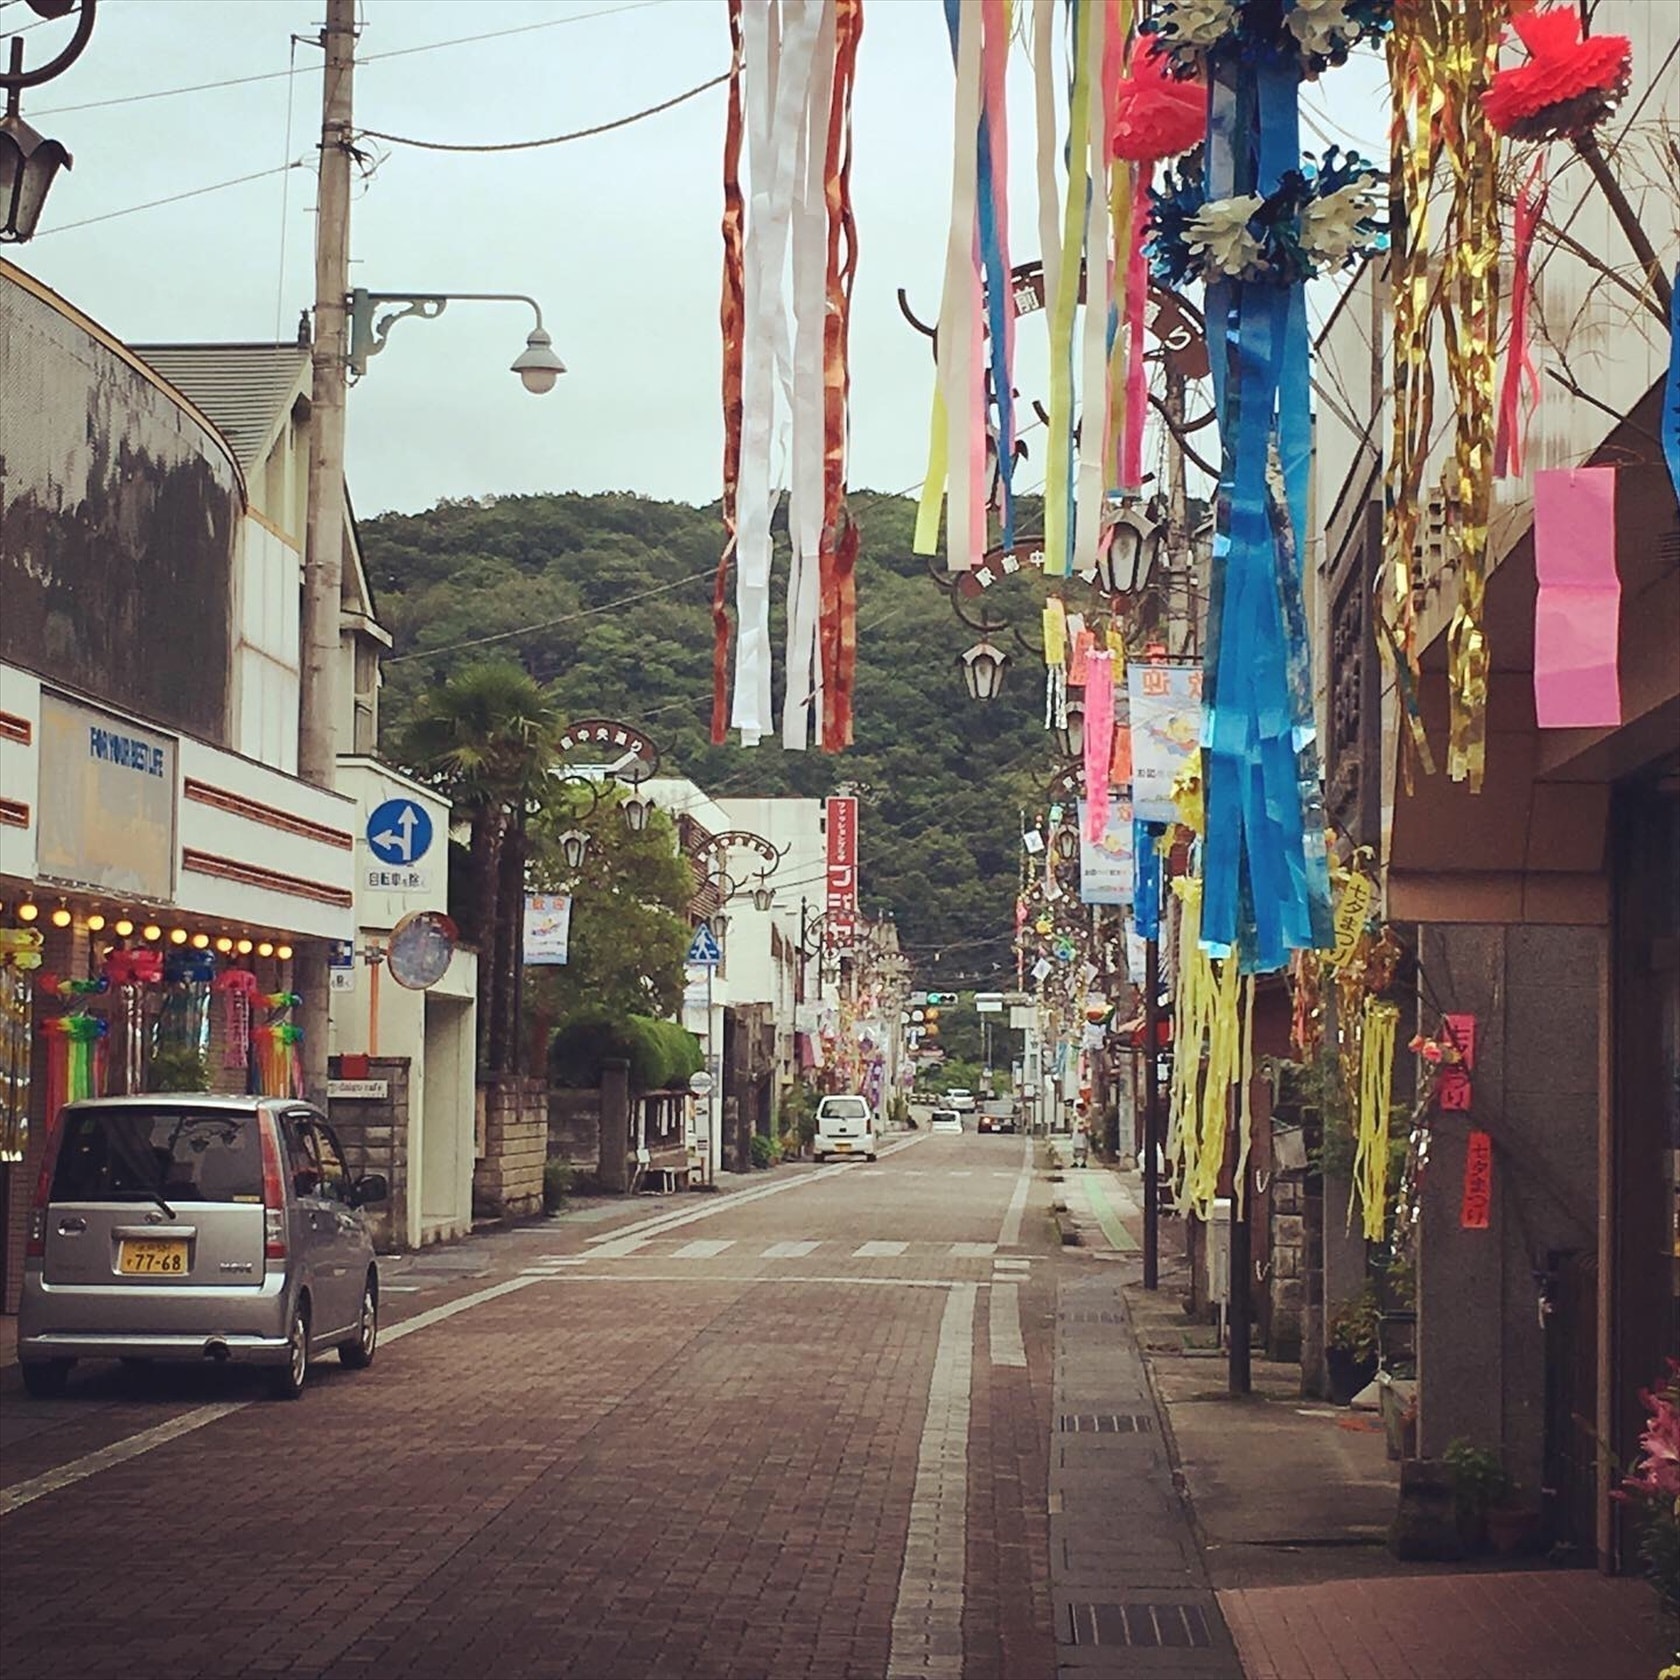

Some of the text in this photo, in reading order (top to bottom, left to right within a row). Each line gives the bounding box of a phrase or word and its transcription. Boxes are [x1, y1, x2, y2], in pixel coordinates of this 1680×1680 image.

[1329, 884, 1367, 962] 七夕まつり
[1446, 1023, 1472, 1107] 七つり
[1465, 1143, 1488, 1225] 七夕まつり
[135, 1254, 181, 1270] 77-68
